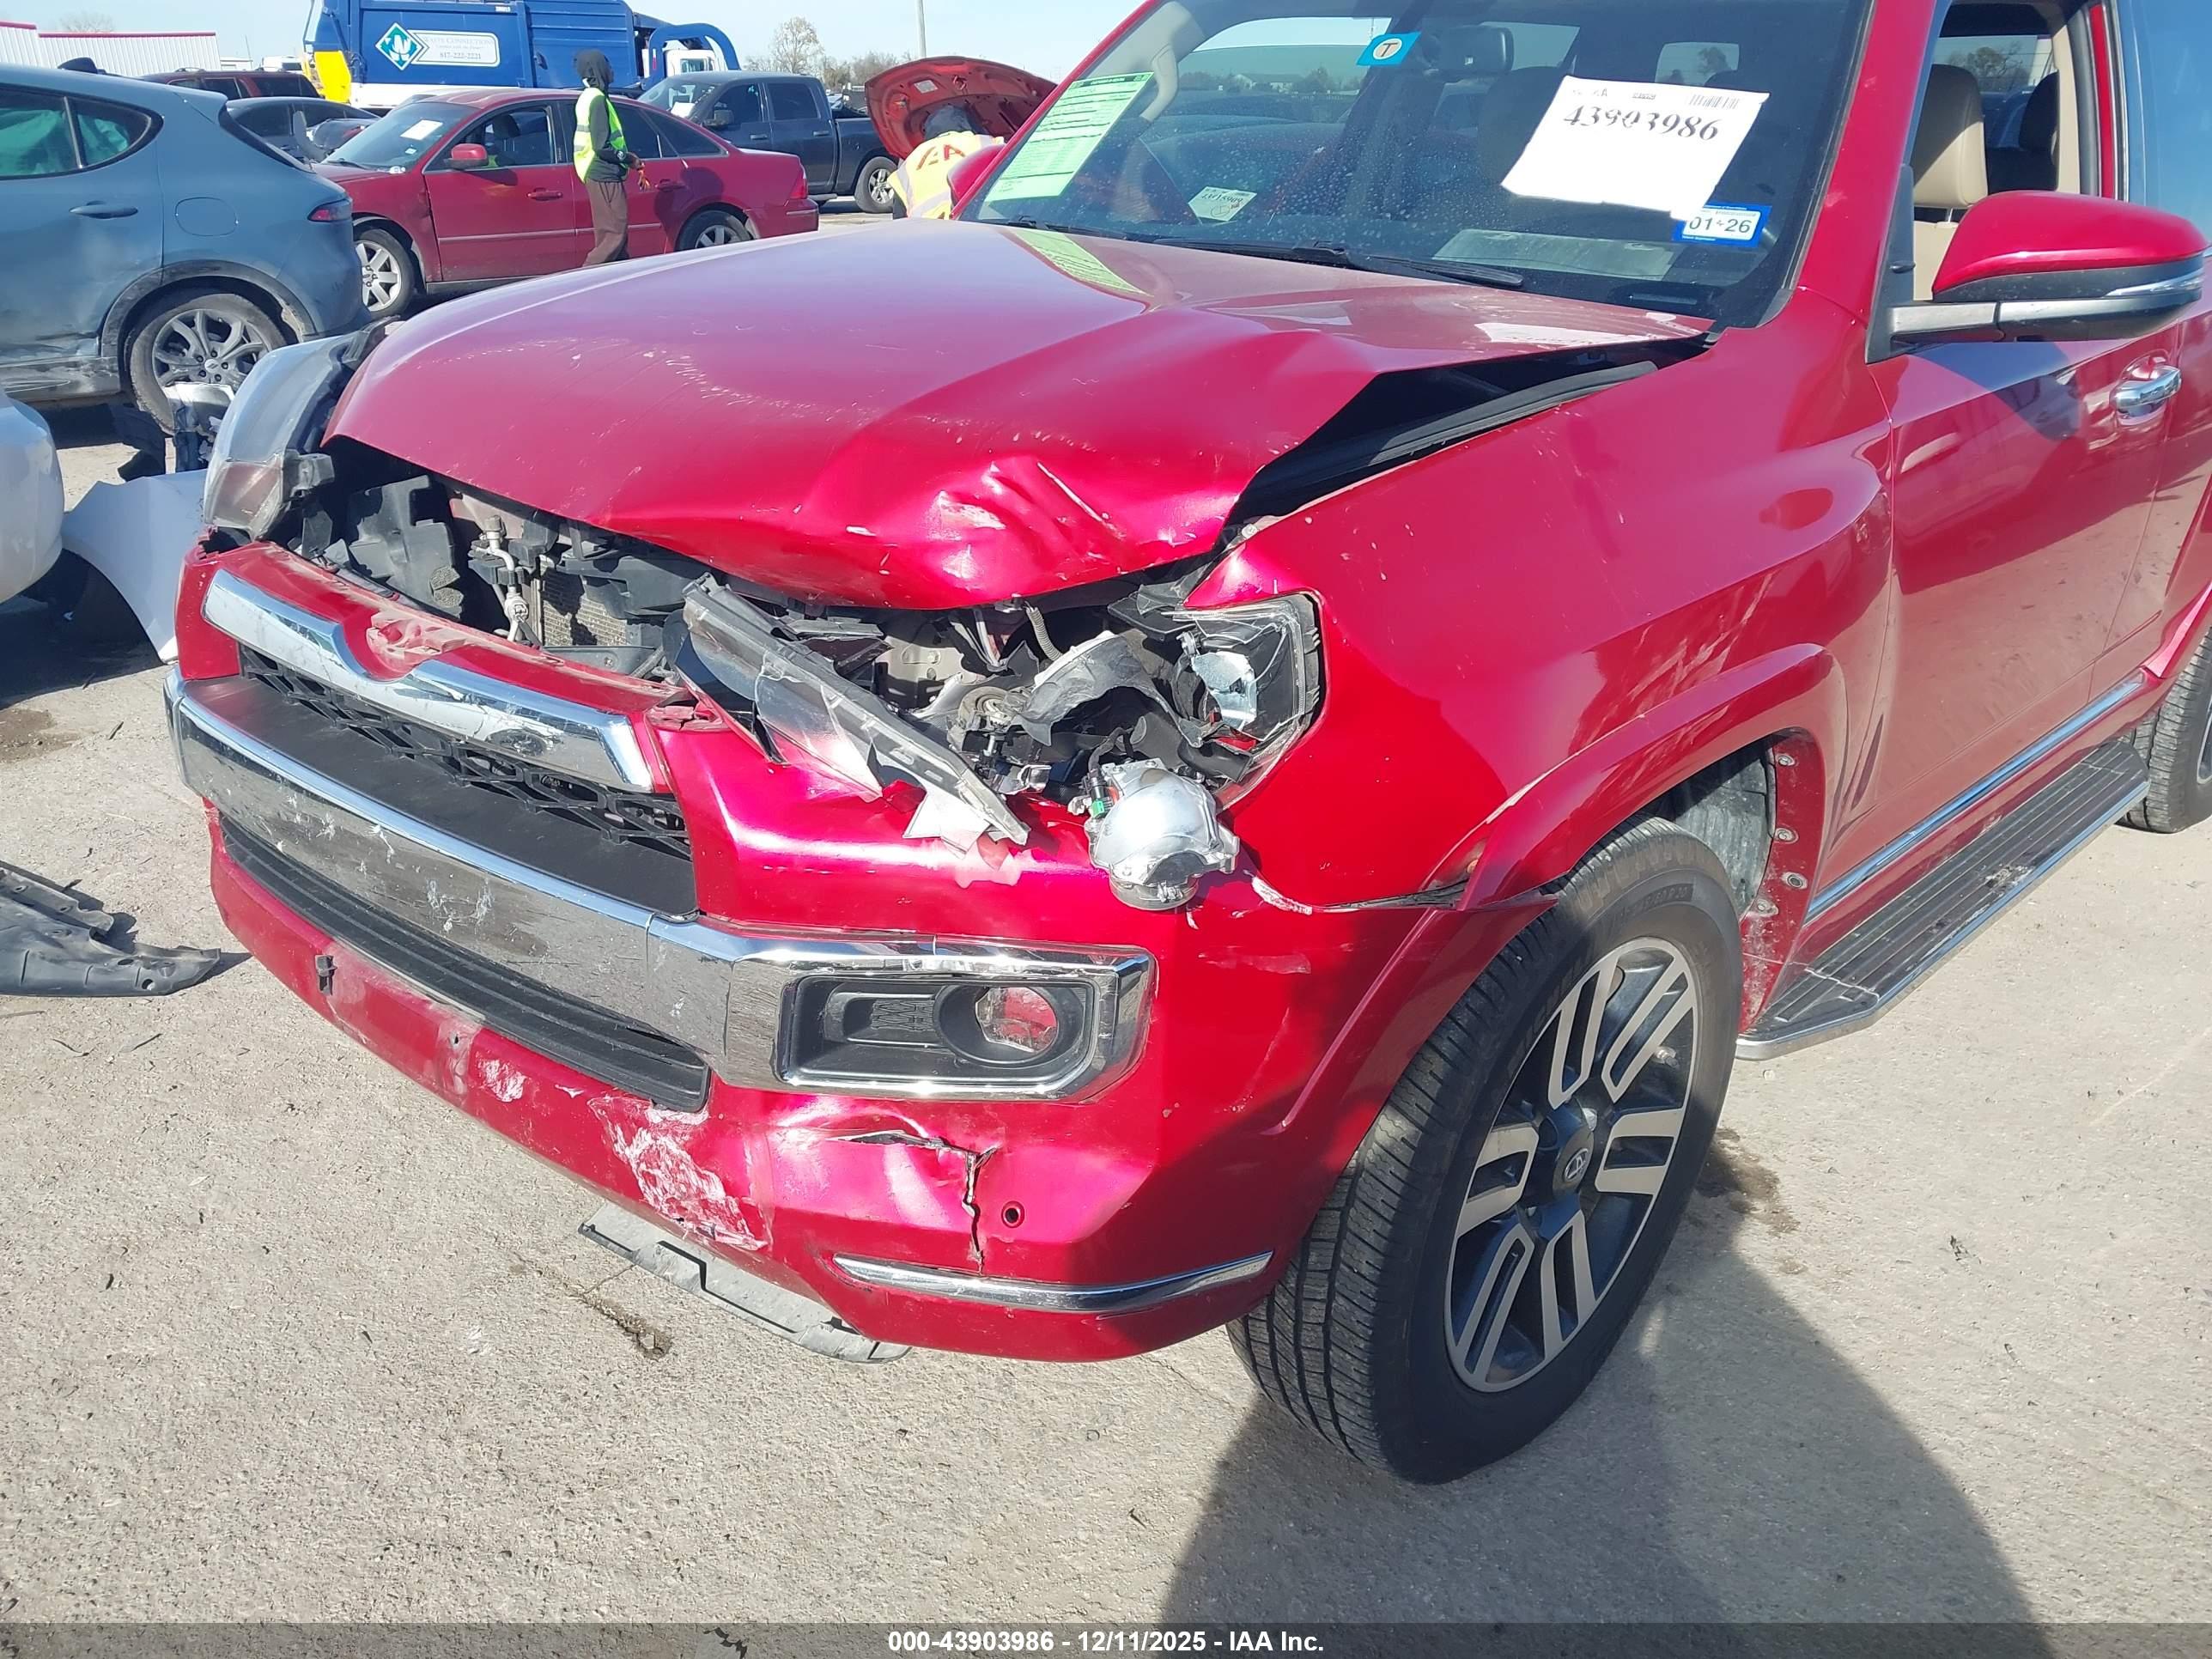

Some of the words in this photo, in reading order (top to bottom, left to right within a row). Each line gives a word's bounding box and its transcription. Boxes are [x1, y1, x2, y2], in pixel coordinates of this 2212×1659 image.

[1380, 42, 1399, 58] T
[1563, 105, 1722, 141] 43903986
[1689, 216, 1713, 230] 01
[1724, 219, 1753, 234] 26
